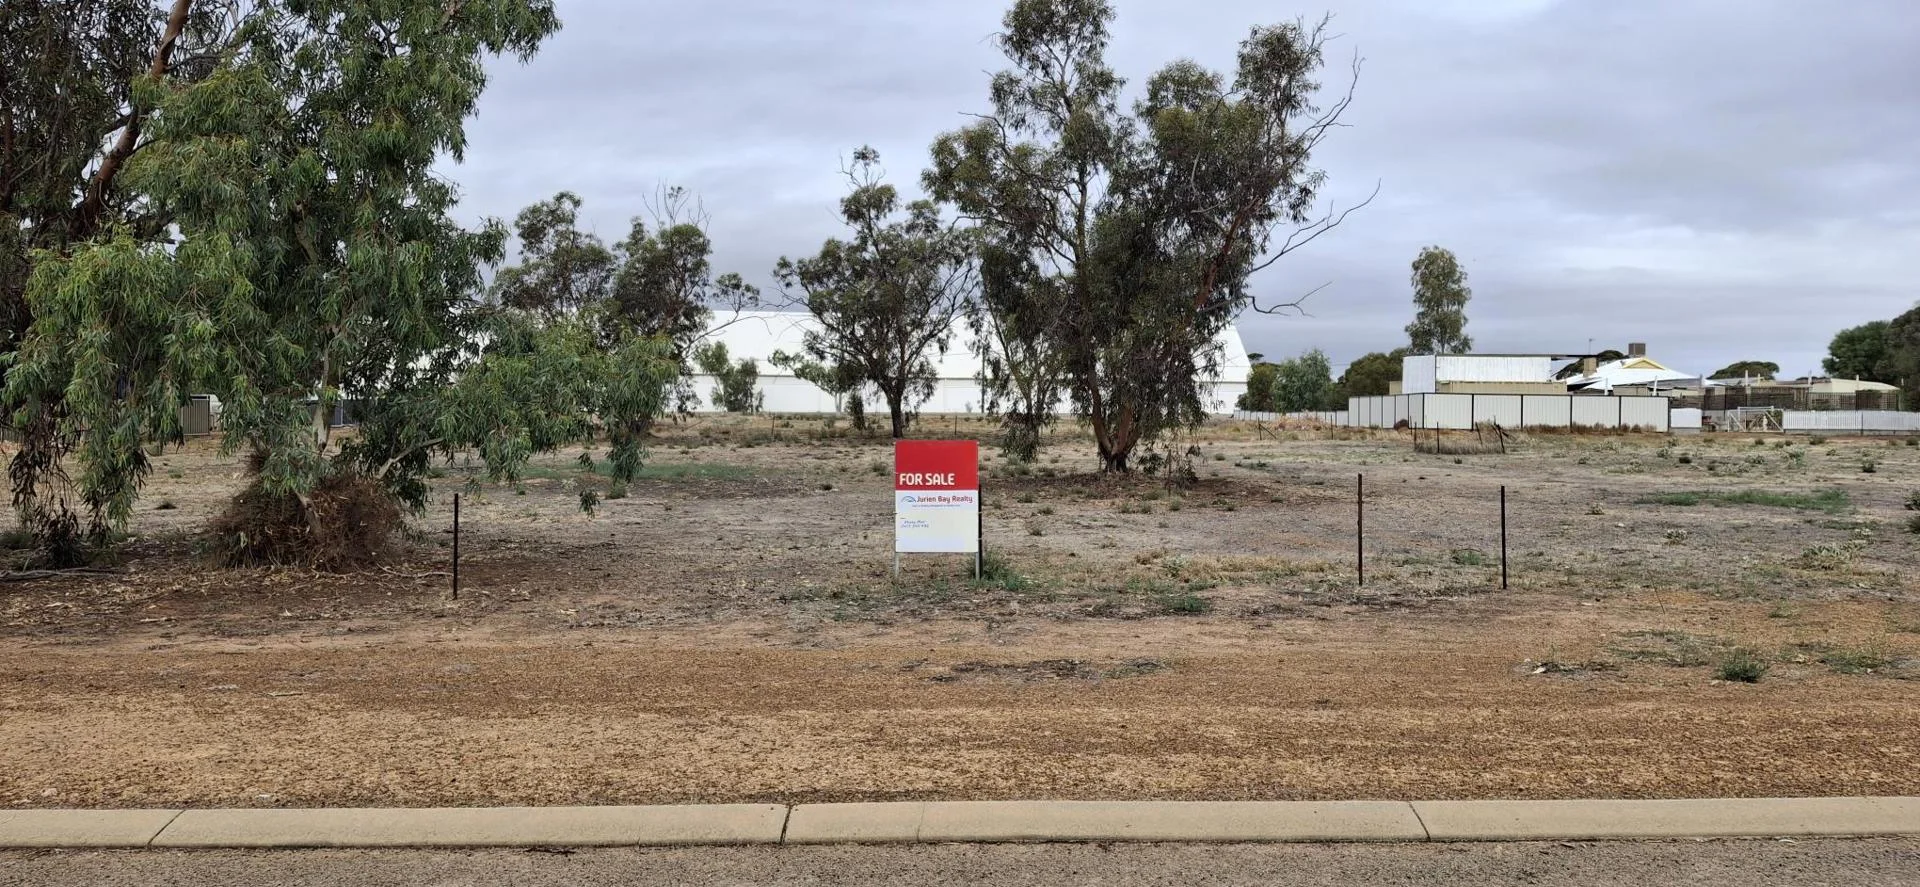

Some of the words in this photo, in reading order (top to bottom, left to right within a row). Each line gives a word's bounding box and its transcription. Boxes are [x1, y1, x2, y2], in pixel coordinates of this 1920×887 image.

[900, 473, 923, 485] FOR
[925, 473, 955, 485] SALE
[917, 495, 937, 503] Jurien
[938, 495, 951, 504] Bay
[952, 495, 973, 504] Realty
